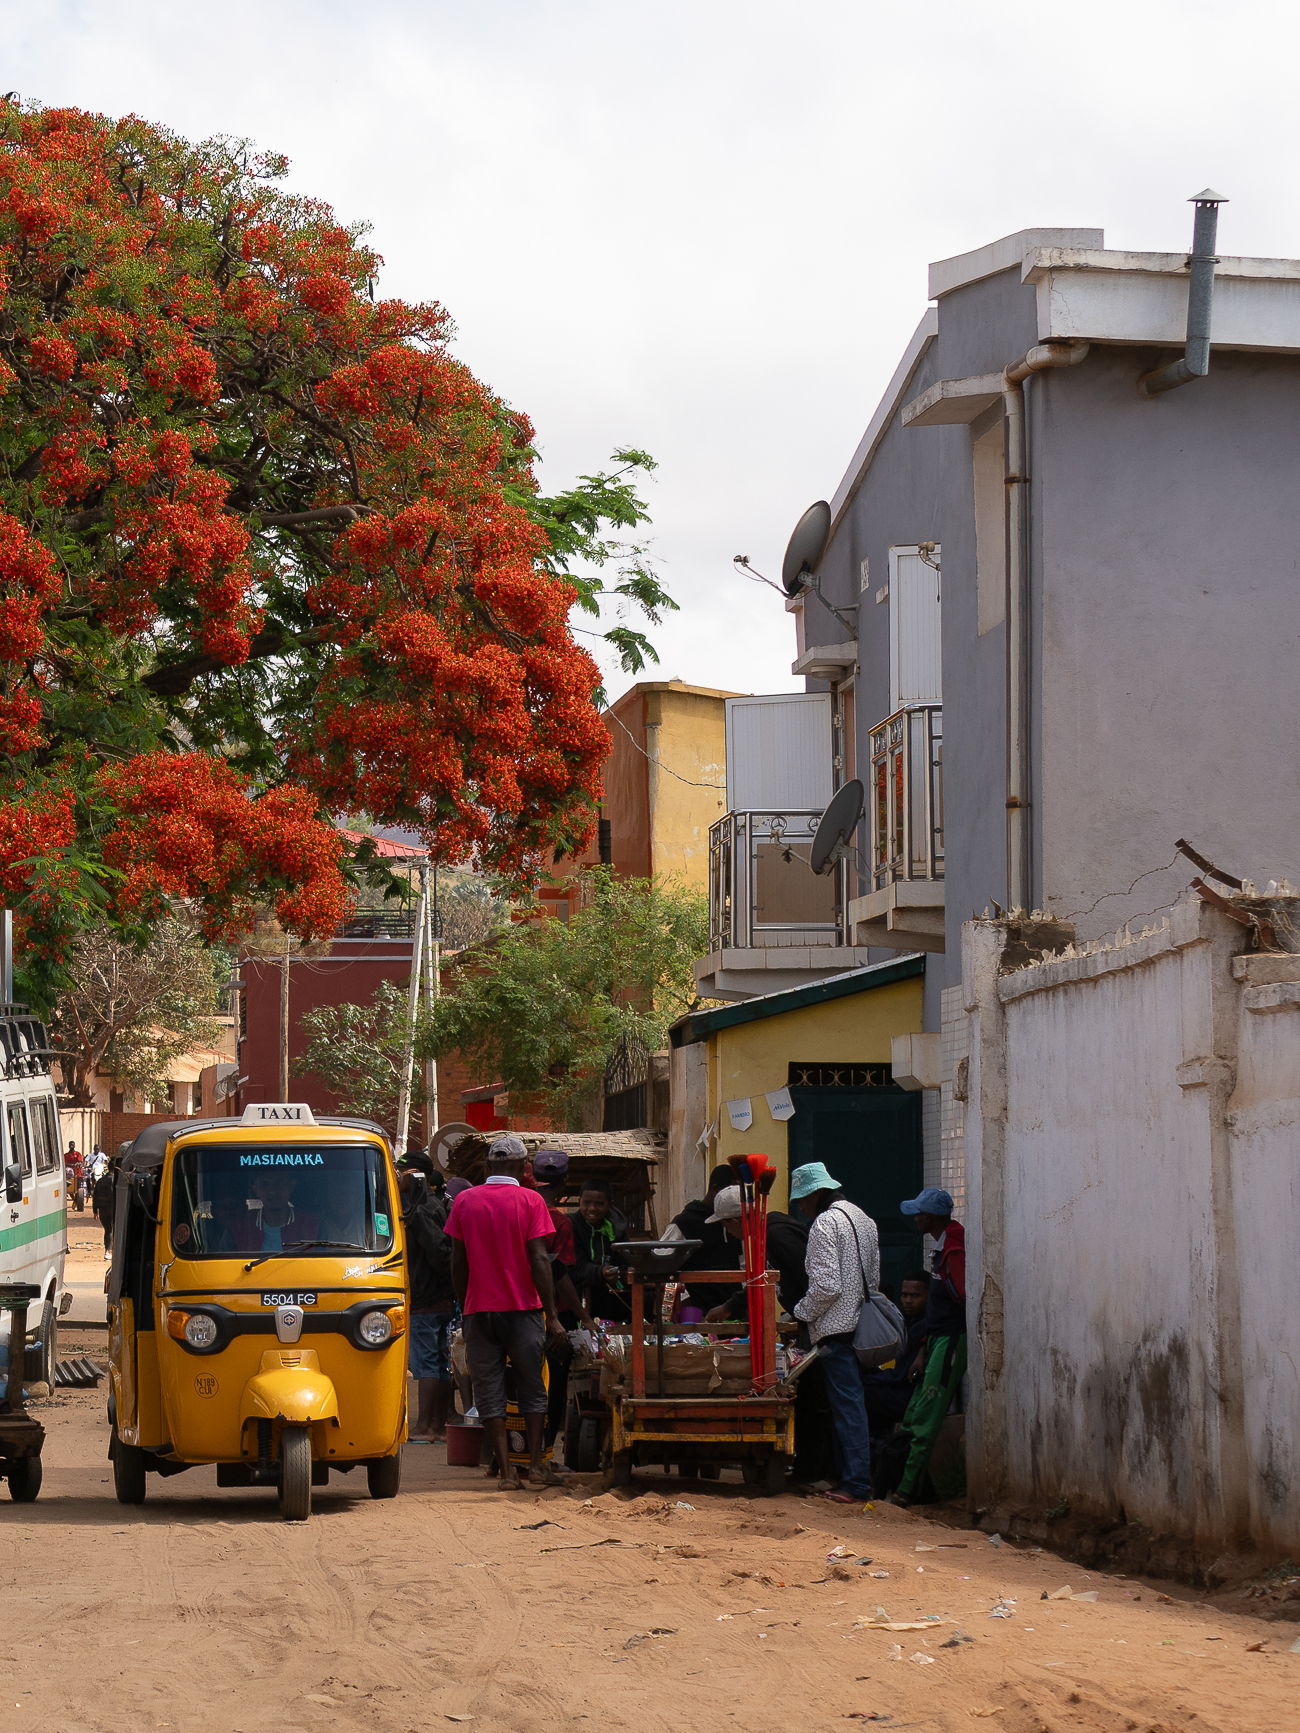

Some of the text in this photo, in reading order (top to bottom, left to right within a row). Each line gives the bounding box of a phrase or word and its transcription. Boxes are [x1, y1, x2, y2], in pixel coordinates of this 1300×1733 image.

[257, 1107, 302, 1120] TAXI
[240, 1153, 324, 1166] MASIANAKA
[263, 1293, 316, 1306] 5504 FG
